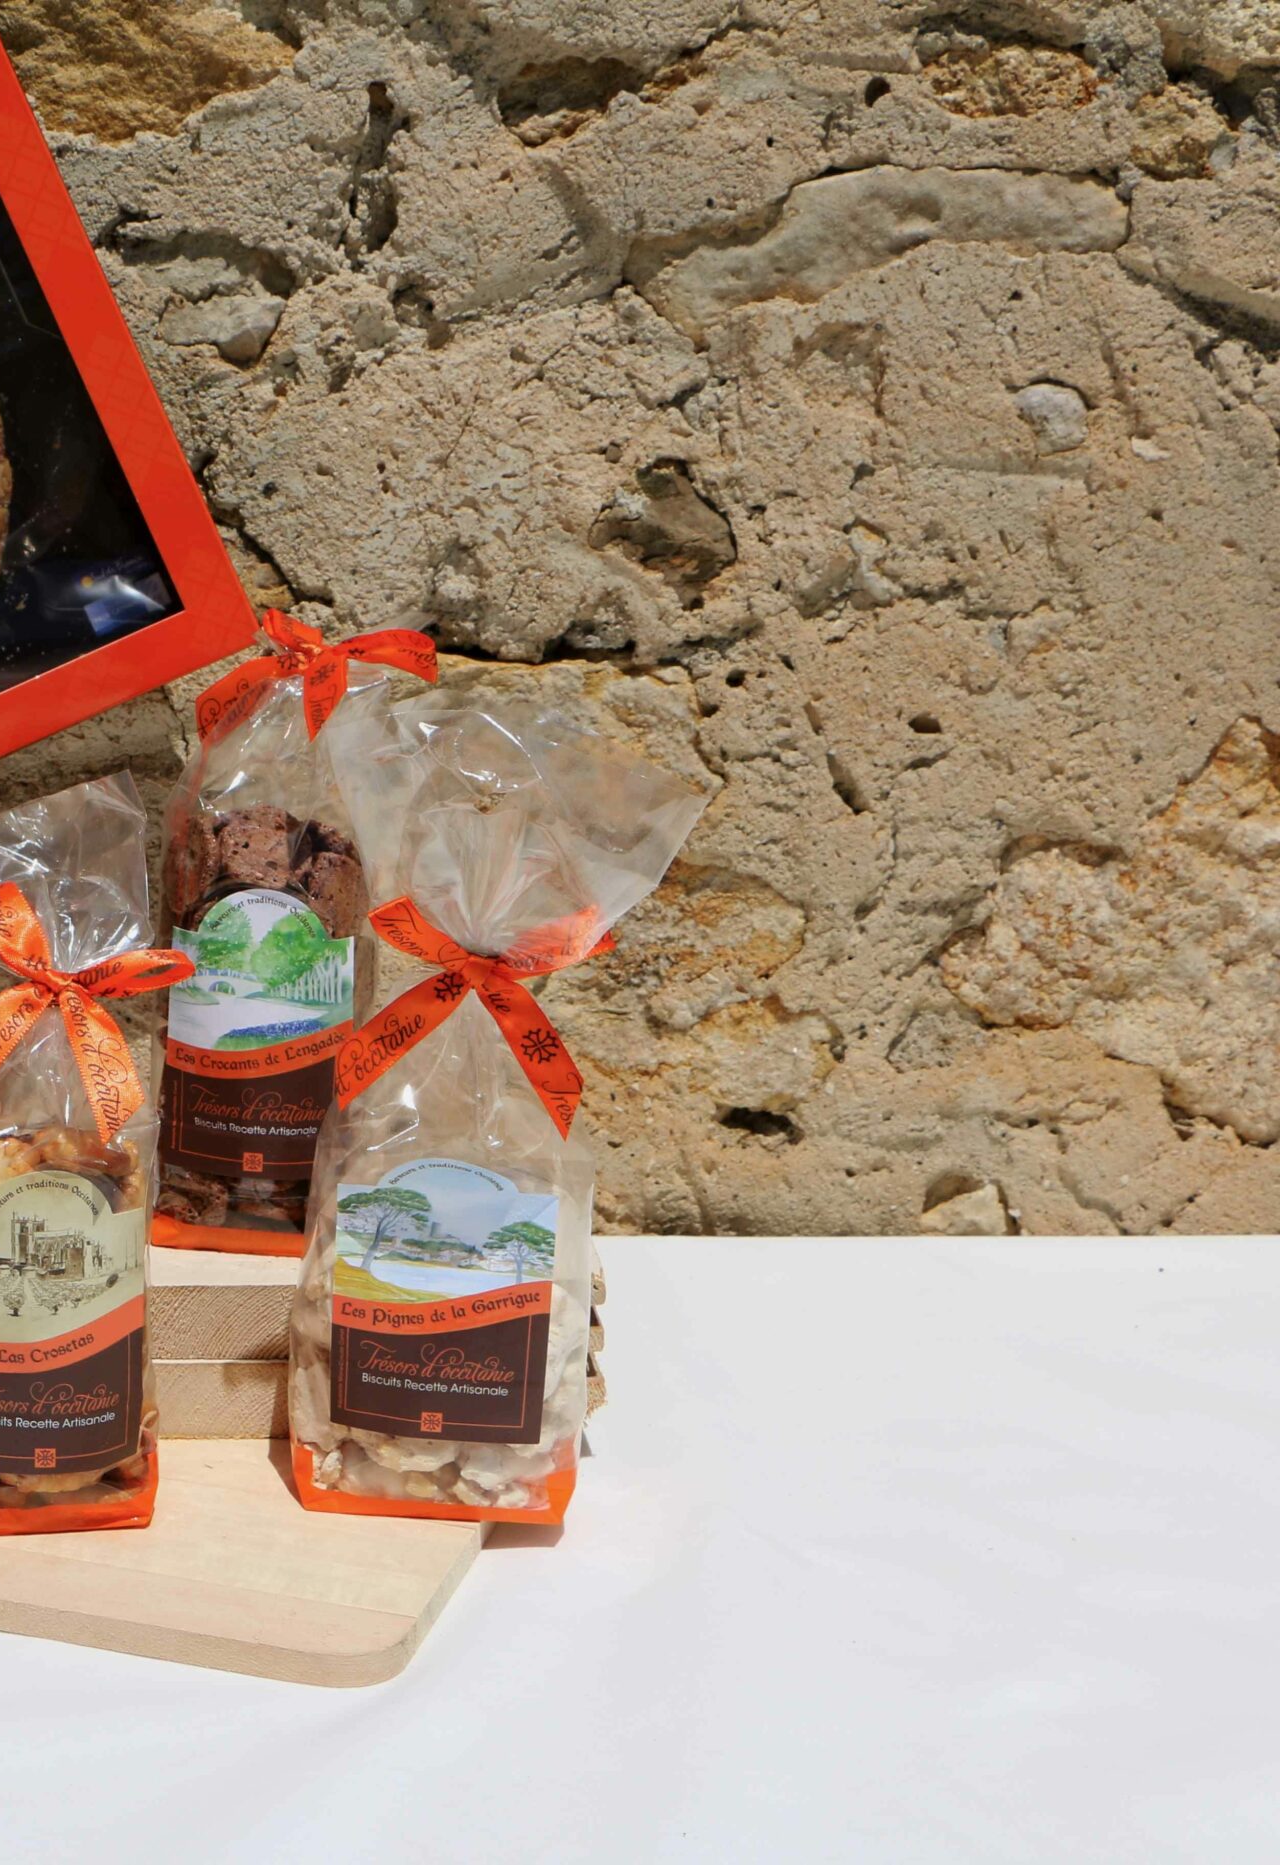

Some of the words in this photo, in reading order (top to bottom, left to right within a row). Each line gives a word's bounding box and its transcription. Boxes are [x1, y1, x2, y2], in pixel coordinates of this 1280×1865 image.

[200, 1054, 260, 1071] Crocants
[265, 1053, 280, 1066] de
[285, 1033, 346, 1061] Lengadòc
[187, 1084, 240, 1120] Trésors
[194, 1116, 227, 1131] Biscuits
[229, 1122, 266, 1135] Recette
[269, 1126, 318, 1138] Artisanale
[341, 1302, 366, 1318] Les
[372, 1308, 425, 1328] Pignes
[430, 1308, 446, 1322] de
[451, 1305, 466, 1318] la
[472, 1291, 540, 1314] Garrigue
[30, 1333, 95, 1364] Crosetas
[358, 1339, 419, 1375] Trésors
[362, 1373, 402, 1388] Biscuits
[404, 1379, 448, 1393] Recette
[450, 1384, 509, 1397] Artisanale
[15, 1418, 60, 1429] Recette
[62, 1411, 116, 1428] Artisanale
